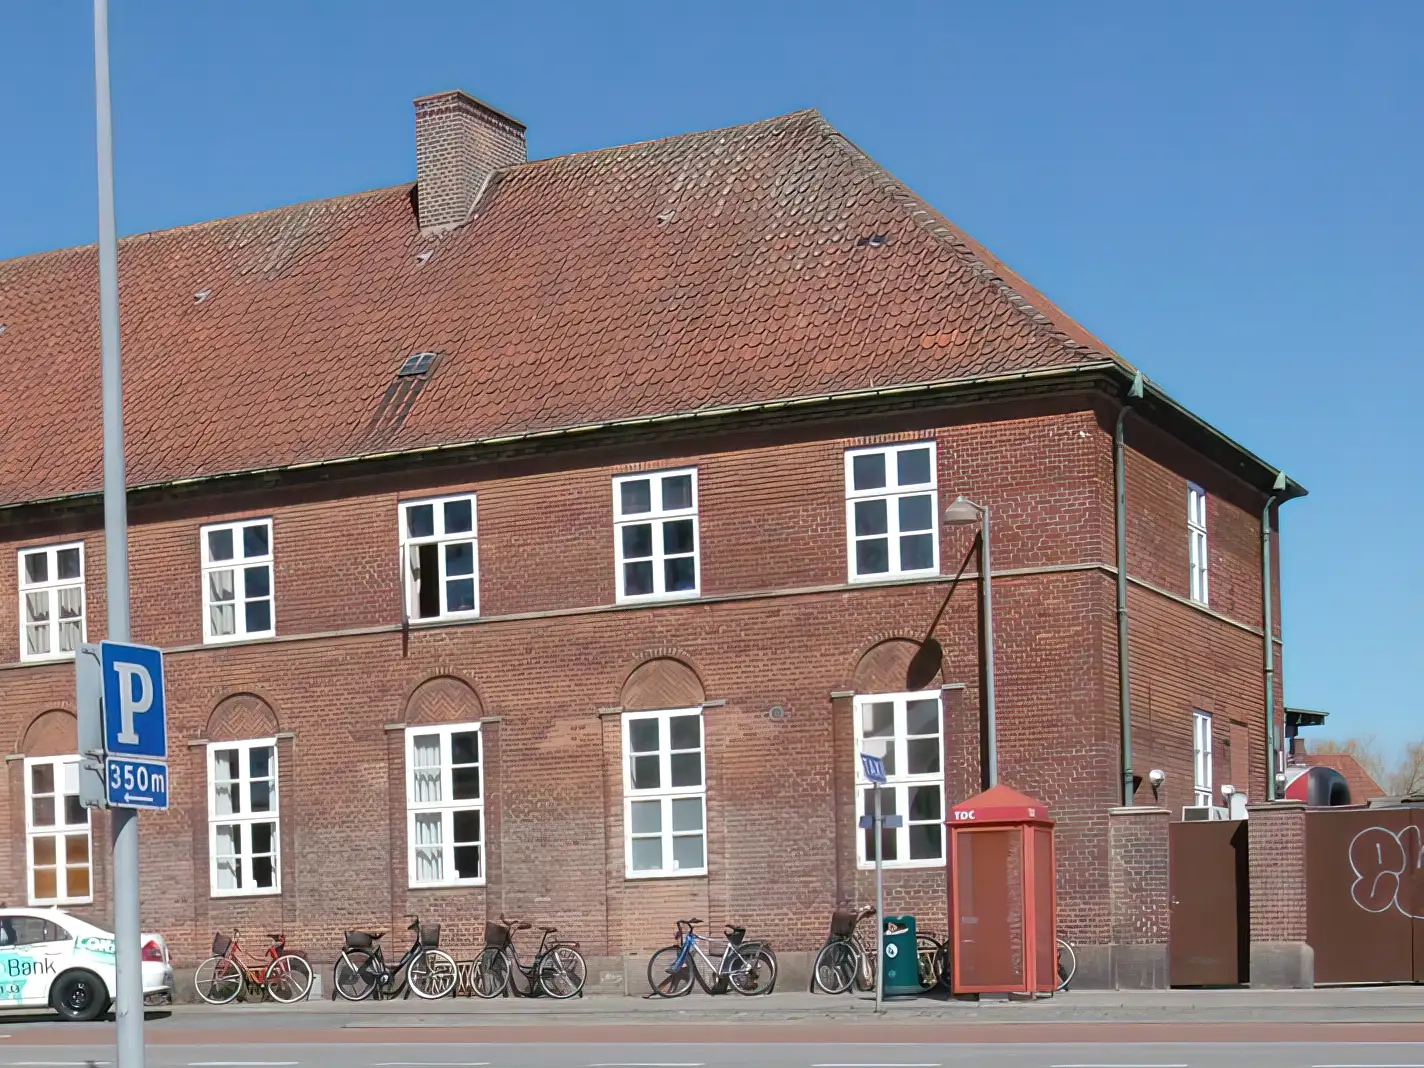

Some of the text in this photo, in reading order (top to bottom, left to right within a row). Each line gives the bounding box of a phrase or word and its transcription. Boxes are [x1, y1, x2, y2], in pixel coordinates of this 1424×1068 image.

[113, 661, 154, 745] P
[862, 756, 887, 777] TAXI
[110, 764, 165, 793] 350m
[954, 810, 976, 820] TDC
[7, 957, 57, 977] Bank
